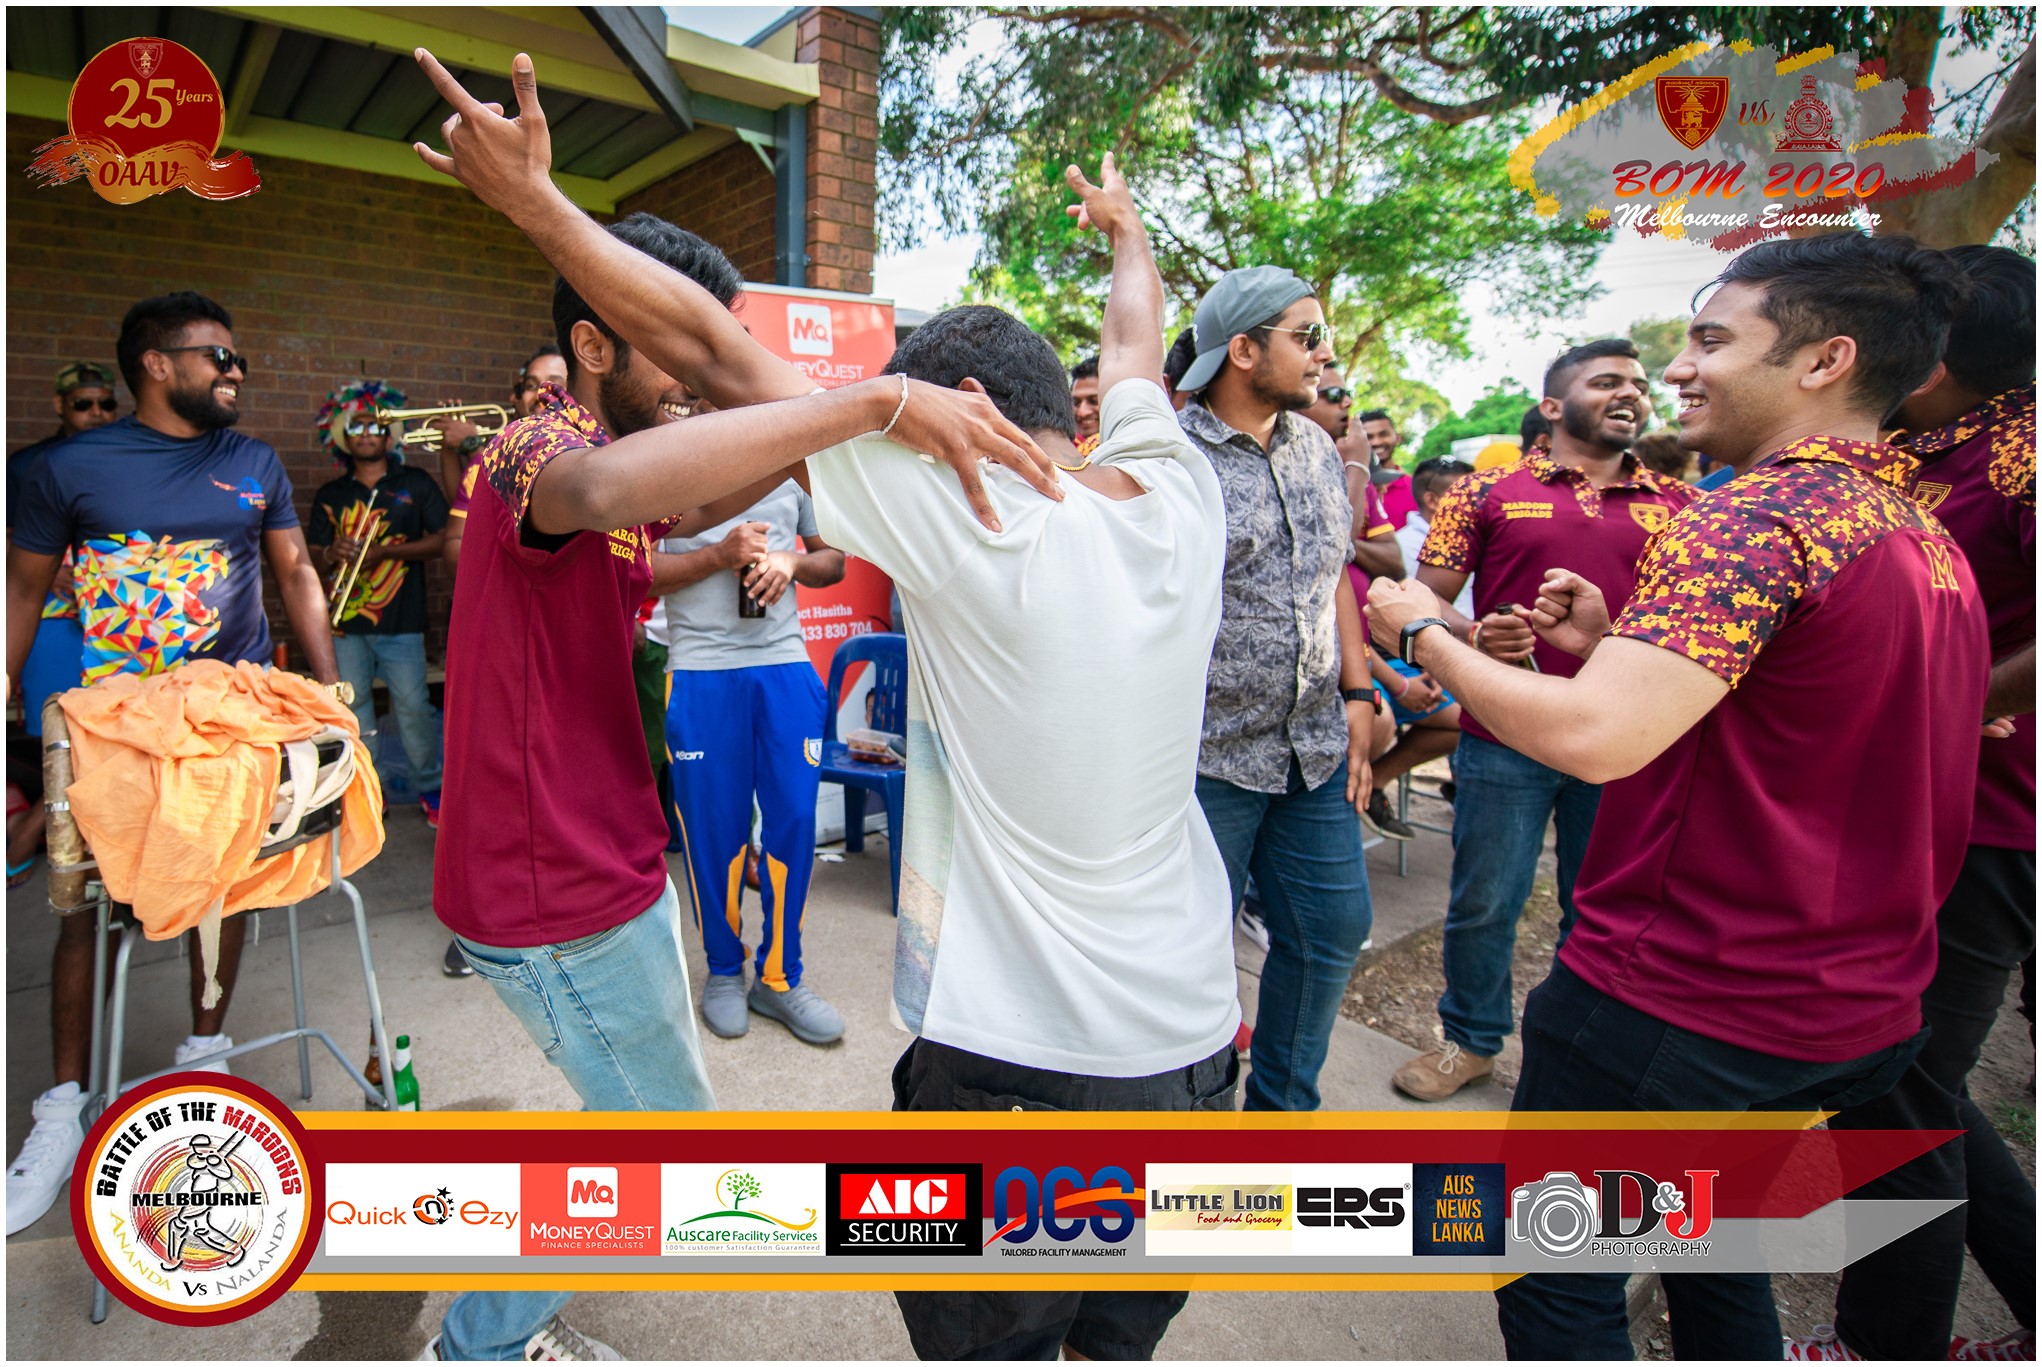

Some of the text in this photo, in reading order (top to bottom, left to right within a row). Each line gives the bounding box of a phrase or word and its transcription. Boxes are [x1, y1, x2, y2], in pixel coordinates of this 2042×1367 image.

[1501, 501, 1553, 511] MAROONS
[1506, 509, 1552, 519] BRIGADE
[1921, 541, 1960, 590] M
[812, 604, 853, 619] Hasitha
[825, 622, 848, 639] 830
